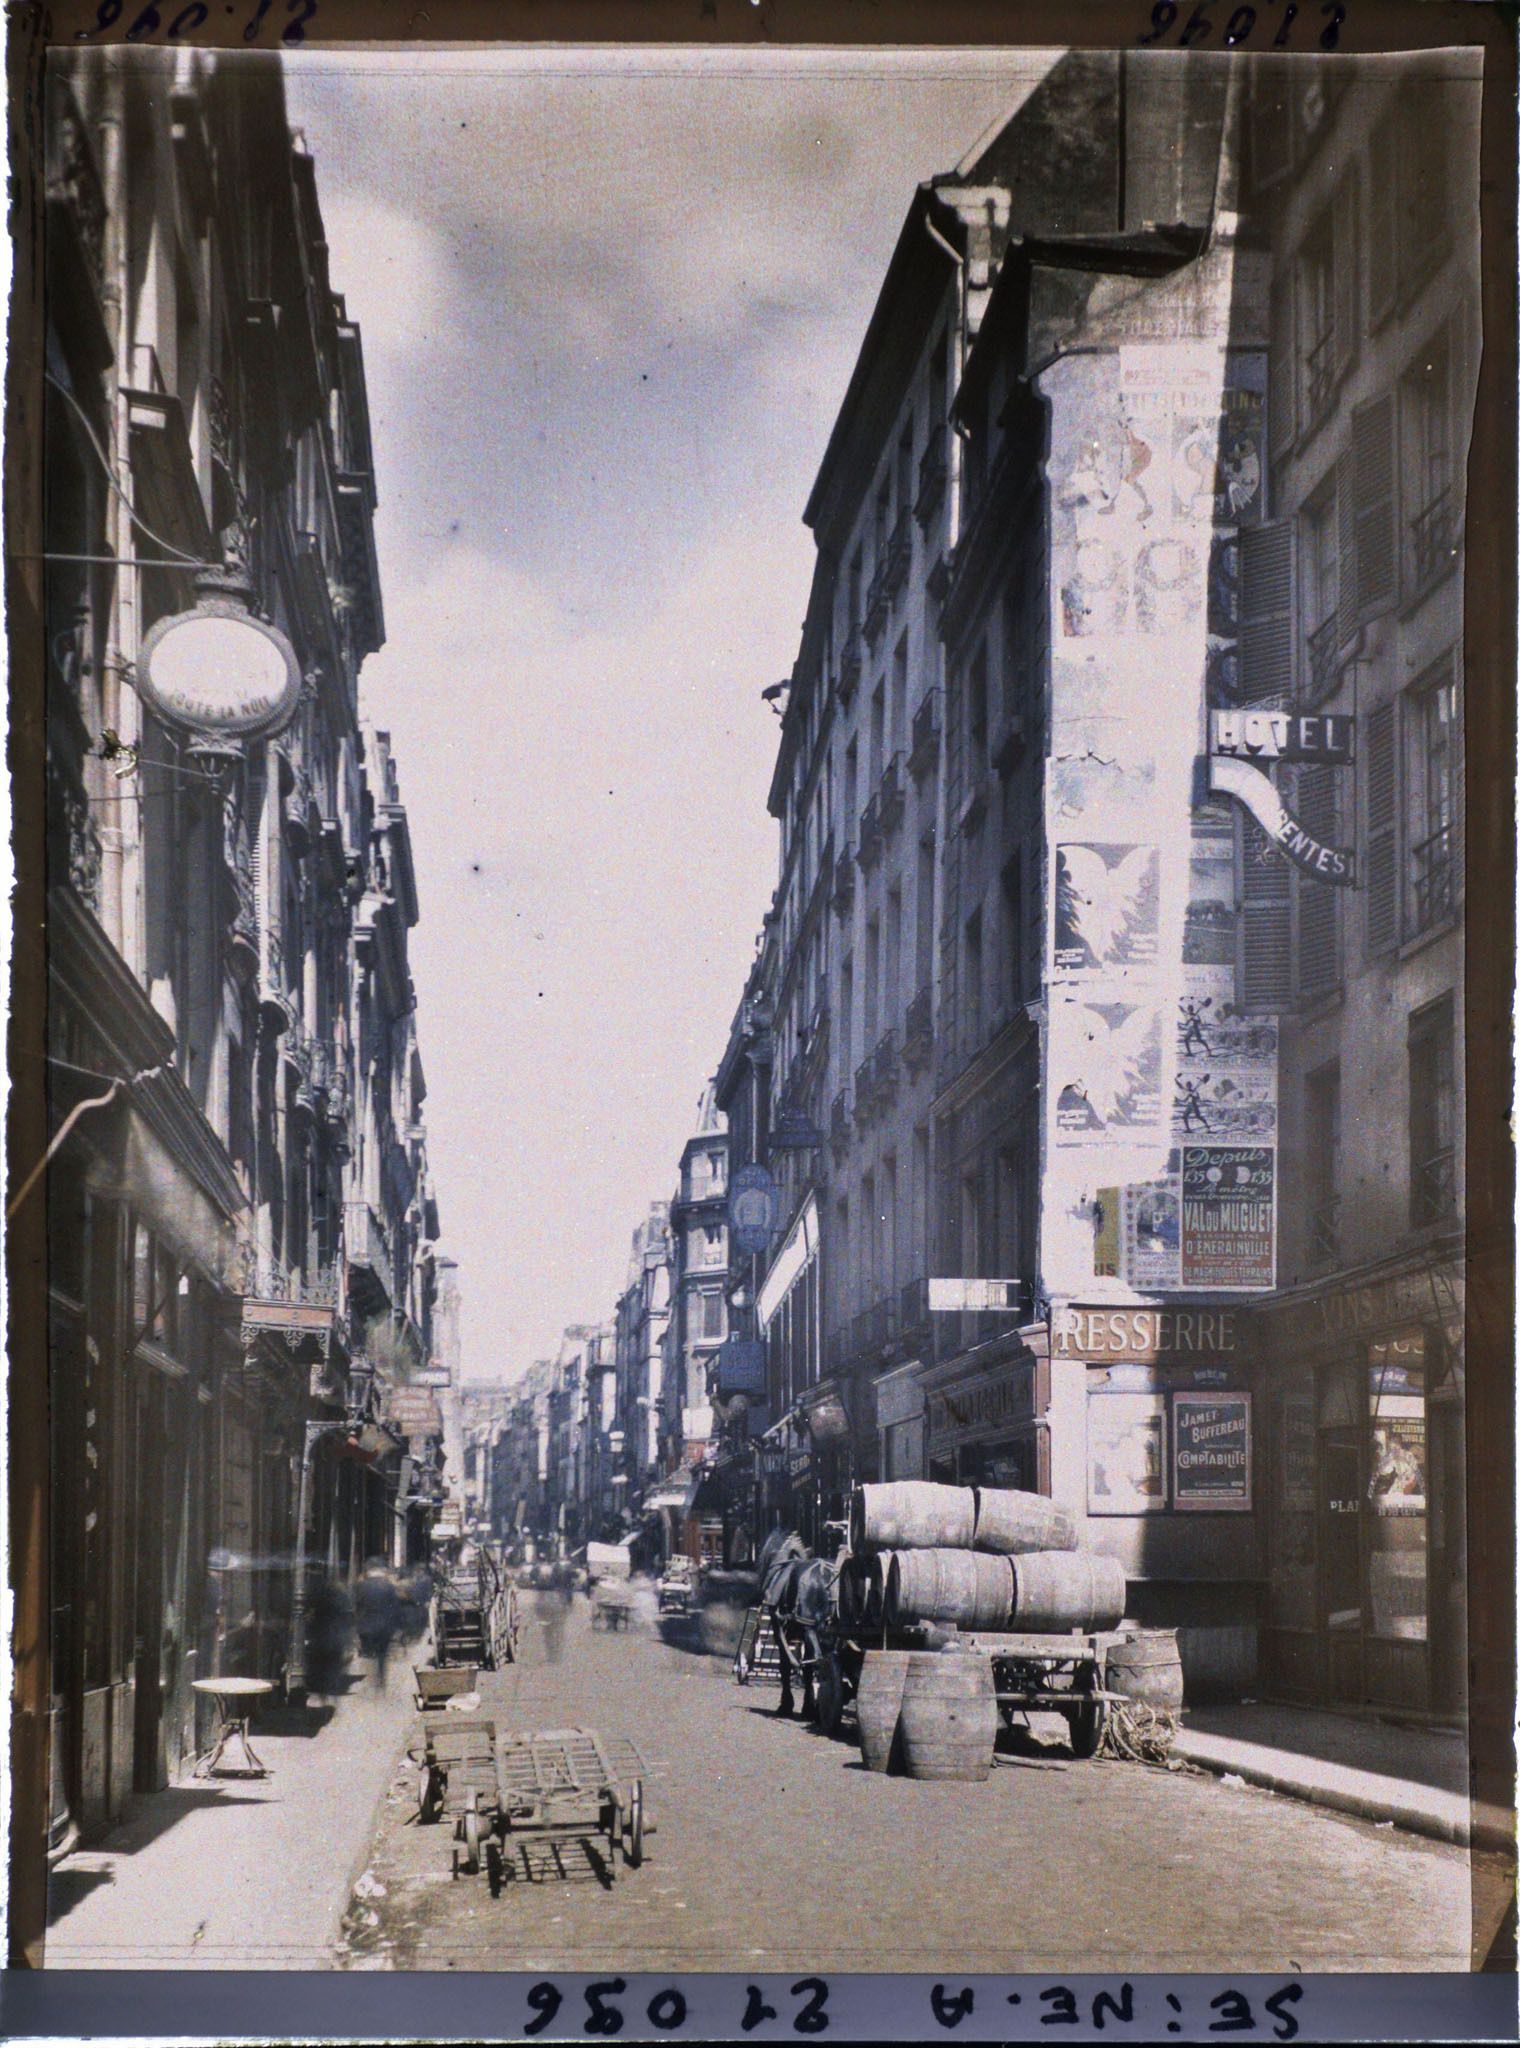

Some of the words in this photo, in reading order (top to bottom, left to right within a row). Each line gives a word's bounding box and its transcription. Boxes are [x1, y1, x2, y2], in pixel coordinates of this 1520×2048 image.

[1218, 712, 1344, 754] HOTEL
[1185, 1148, 1272, 1168] Depuis
[1184, 1202, 1205, 1231] VAL
[1221, 1202, 1273, 1232] MUGUET
[1058, 1310, 1236, 1352] RESSERRE
[1192, 1418, 1246, 1443] BUFFEREAU
